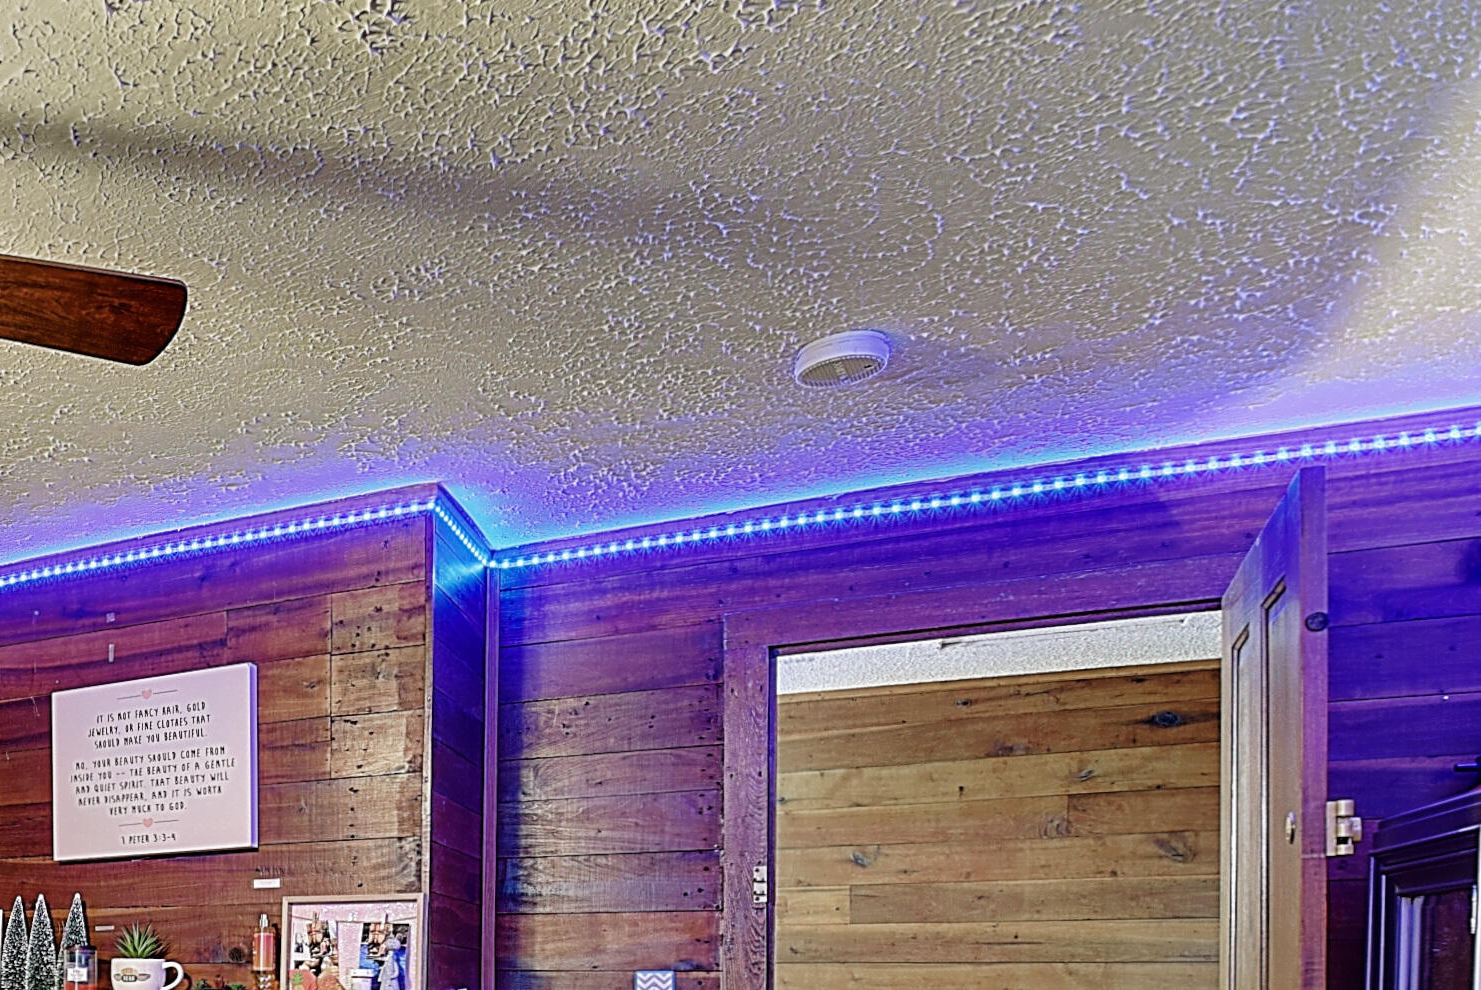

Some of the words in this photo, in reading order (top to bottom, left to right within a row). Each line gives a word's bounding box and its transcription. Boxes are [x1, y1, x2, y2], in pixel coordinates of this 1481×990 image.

[96, 715, 103, 724] IT
[108, 713, 114, 722] IS
[118, 711, 131, 721] NOT
[135, 708, 159, 719] FANCY
[186, 702, 206, 712] GOLD
[125, 724, 134, 732] OR
[138, 721, 153, 731] FINE
[157, 718, 188, 729] CLOTHES
[192, 714, 210, 724] THAT
[95, 738, 120, 749] SHOULD
[124, 736, 142, 745] MAKE
[146, 734, 160, 743] YOU
[93, 759, 111, 768] YOUR
[114, 755, 144, 766] BEAUTY
[148, 752, 176, 763] SHOULD
[181, 749, 200, 759] COME
[205, 746, 225, 756] FROM
[70, 772, 93, 783] INSIDE
[98, 771, 112, 780] YOU
[130, 767, 142, 777] THE
[147, 764, 177, 775] BEAUTY
[182, 763, 191, 772] OF
[194, 762, 200, 771] A
[205, 758, 235, 769] GENTLE
[75, 785, 90, 795] AND
[94, 782, 116, 793] QUIET
[150, 777, 170, 788] THAT
[174, 774, 206, 785] BEAUTY
[210, 771, 229, 781] WILL
[78, 796, 100, 806] NEVER
[151, 790, 167, 800] AND
[171, 789, 180, 798] IT
[184, 788, 192, 797] IS
[196, 785, 222, 796] WORTH
[109, 807, 127, 816] VERY
[131, 804, 151, 814] MUCH
[156, 803, 165, 812] TO
[129, 834, 149, 844] PETER
